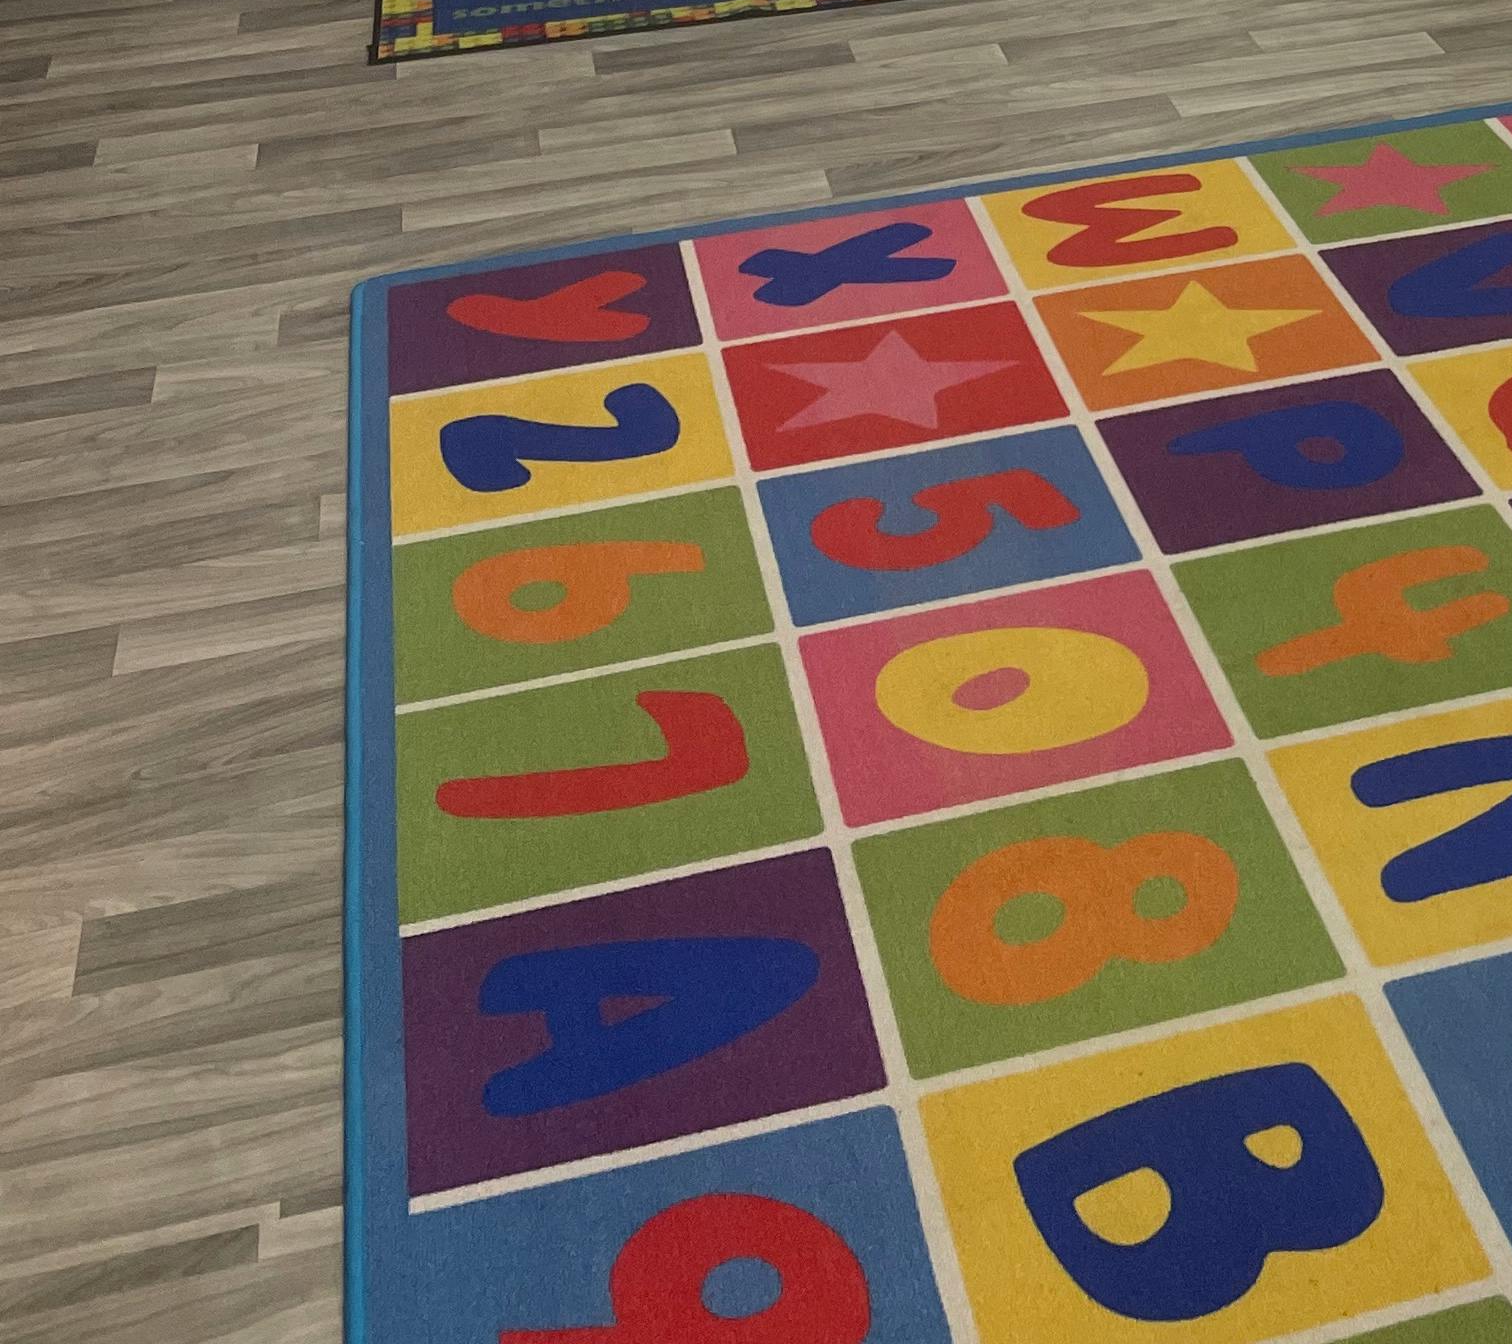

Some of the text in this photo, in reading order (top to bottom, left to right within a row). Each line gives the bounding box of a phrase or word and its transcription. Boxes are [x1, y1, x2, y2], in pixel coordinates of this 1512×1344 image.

[741, 223, 955, 306] X
[1023, 174, 1236, 267] W
[1169, 399, 1405, 491] P
[813, 471, 1076, 568] 5
[1258, 547, 1508, 675] 4
[437, 692, 748, 817] 7
[930, 832, 1237, 1004] 8
[479, 936, 819, 1118] A
[1016, 1064, 1383, 1320] B
